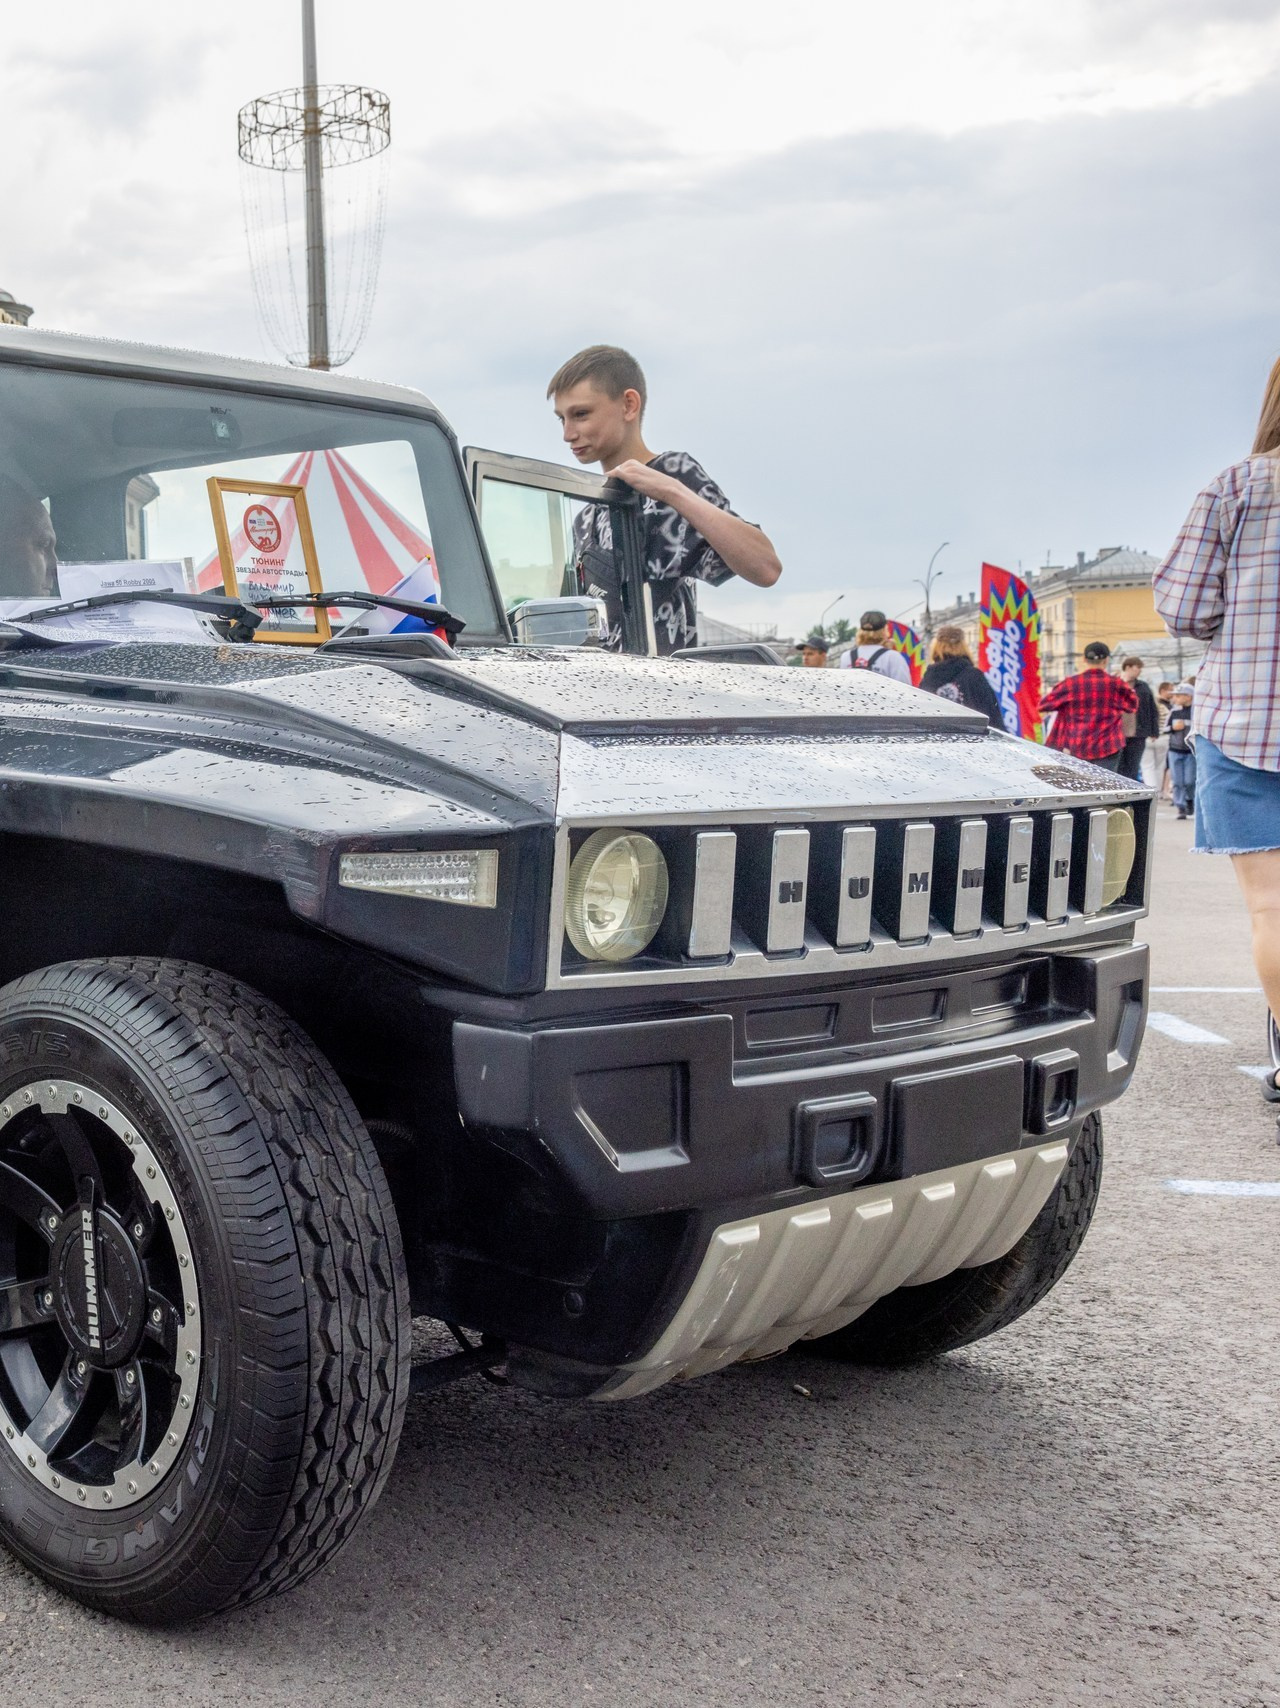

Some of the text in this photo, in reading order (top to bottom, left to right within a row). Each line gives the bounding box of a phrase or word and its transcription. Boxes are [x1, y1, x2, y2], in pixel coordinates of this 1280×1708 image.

[235, 566, 304, 577] ЗВЕЗДА АВТОСТРАДЫ
[251, 557, 285, 567] ТЮНИНГ
[984, 628, 1004, 693] ЬФА
[778, 858, 1069, 904] HUMMER
[82, 1209, 100, 1348] HUMMER
[18, 1338, 222, 1566] TRIANGLE
